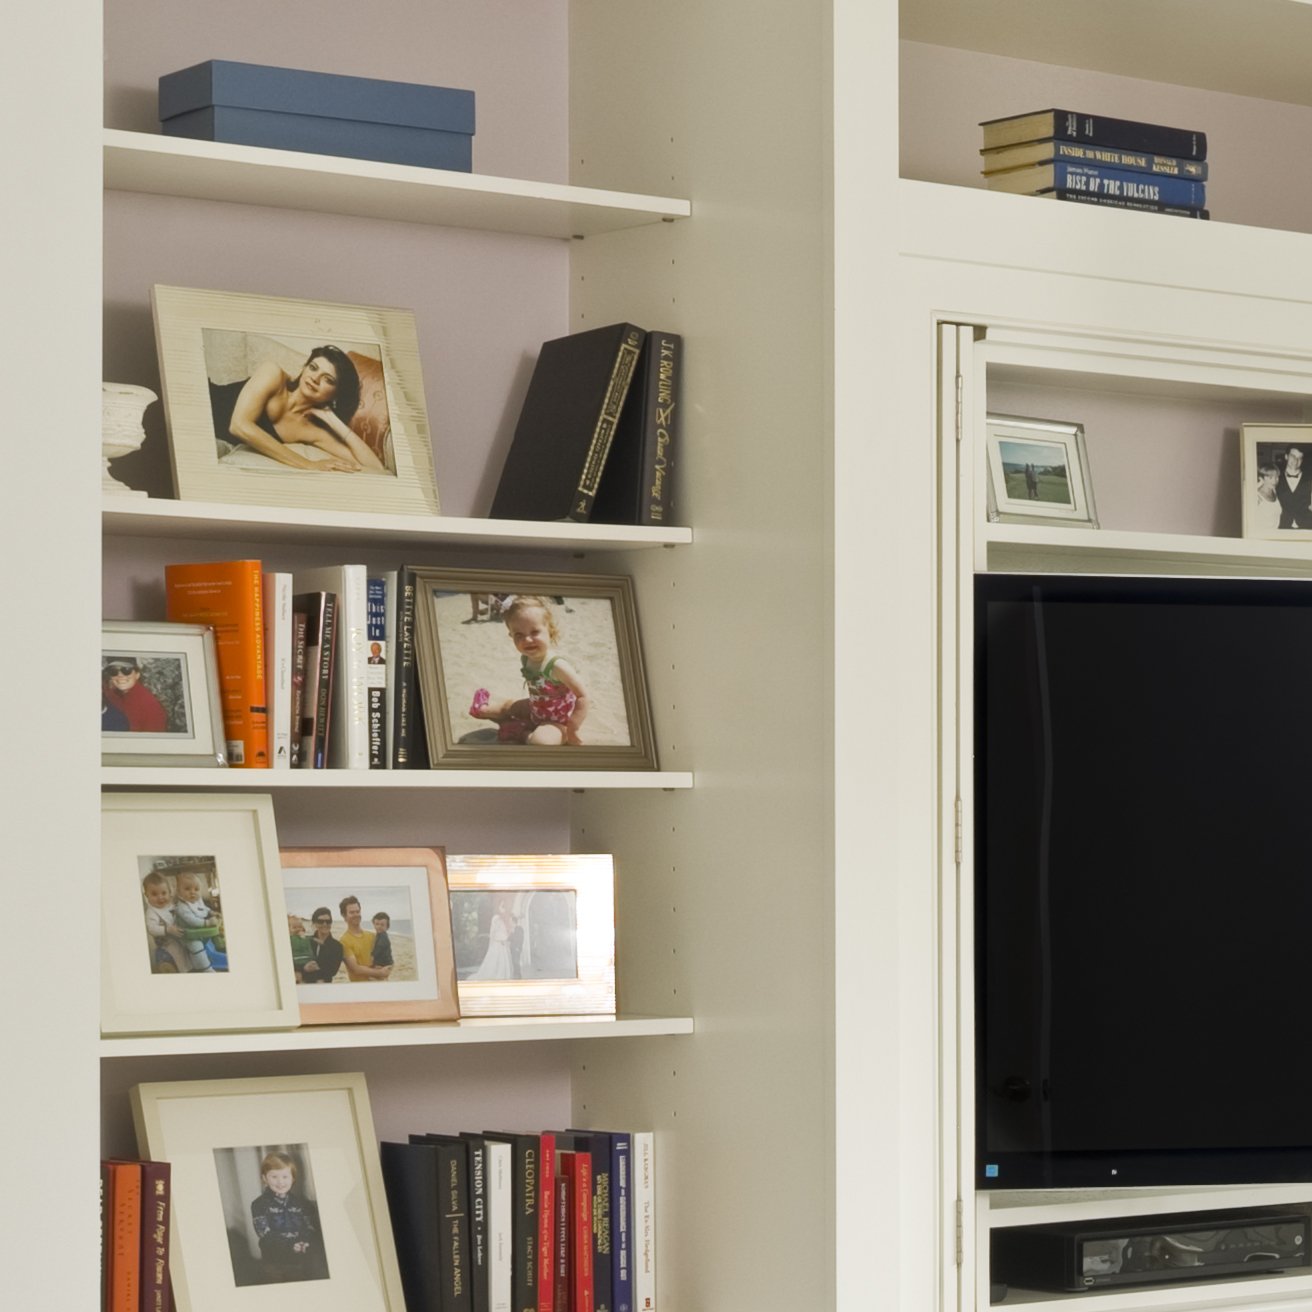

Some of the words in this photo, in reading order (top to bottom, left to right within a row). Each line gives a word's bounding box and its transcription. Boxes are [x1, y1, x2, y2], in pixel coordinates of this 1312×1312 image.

[1059, 145, 1085, 158] INSIDE
[1095, 150, 1120, 164] WHITE
[1121, 154, 1147, 167] HOUSE
[1152, 163, 1179, 174] KESSLER
[1066, 174, 1086, 190] RISE
[1089, 178, 1101, 192] OF
[1103, 179, 1120, 195] THE
[1123, 182, 1159, 201] VULCANS
[658, 365, 673, 405] ROWLING
[403, 585, 413, 622] BETTYE
[324, 627, 332, 640] ME
[367, 614, 385, 625] Just
[371, 626, 380, 637] In
[255, 633, 263, 680] ADVANTAGE
[296, 640, 305, 670] SECRET
[321, 651, 331, 681] STORY
[319, 688, 327, 705] DON
[371, 691, 381, 708] Bob
[317, 706, 326, 737] HEWITT
[371, 712, 381, 754] Schieffer
[450, 1159, 458, 1188] DANIEL
[474, 1149, 484, 1195] TENSION
[525, 1149, 535, 1215] CLEOPATRA
[450, 1189, 459, 1211] SILVA
[601, 1173, 609, 1215] MICHAEL
[156, 1200, 166, 1221] From
[474, 1198, 484, 1222] CITY
[452, 1219, 460, 1234] THE
[602, 1217, 610, 1254] REAGAN
[452, 1236, 461, 1266] FALLEN
[453, 1267, 462, 1297] ANGEL
